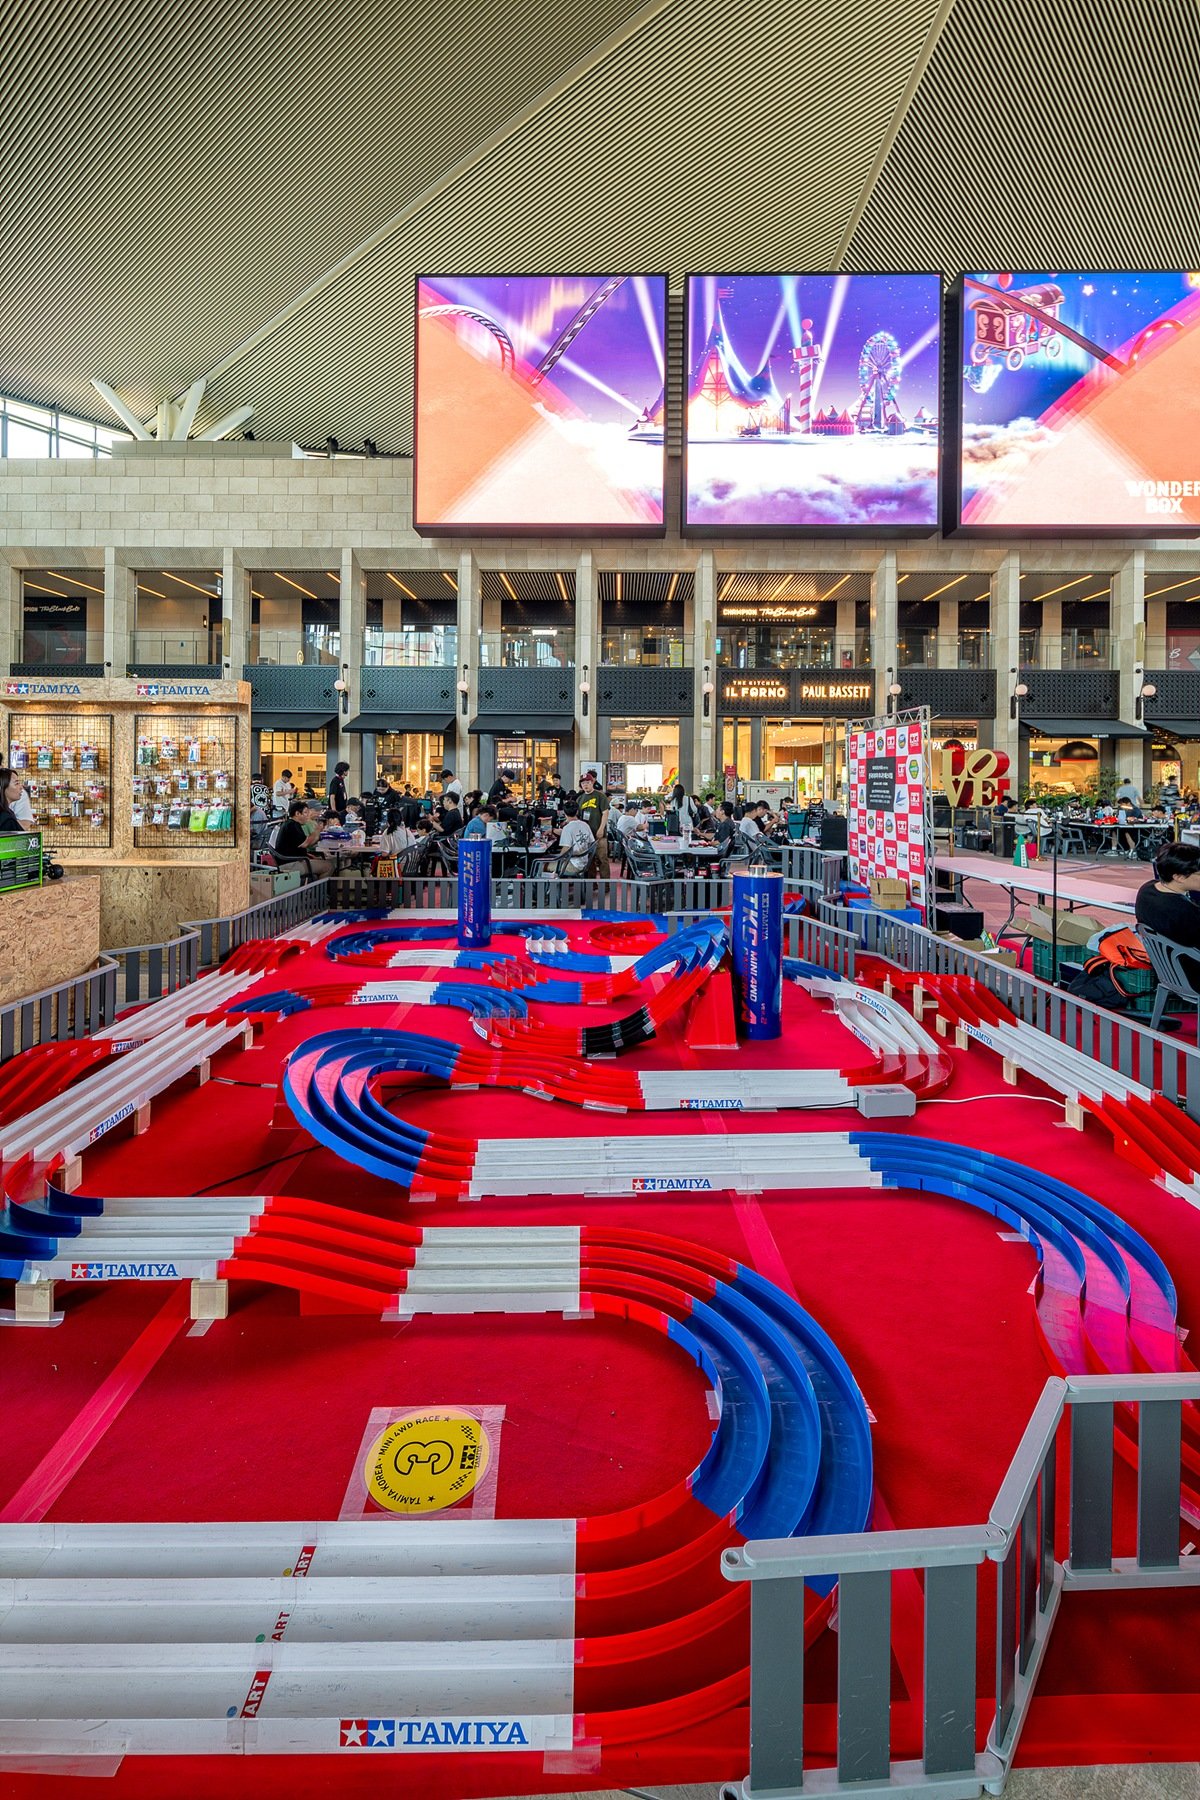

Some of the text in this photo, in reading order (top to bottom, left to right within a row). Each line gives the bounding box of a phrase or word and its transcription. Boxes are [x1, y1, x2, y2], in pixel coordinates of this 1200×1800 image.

[1145, 497, 1184, 514] BOX
[30, 685, 80, 694] TAMIYA
[160, 686, 210, 695] TAMIYA
[725, 687, 786, 698] IL FORNO
[802, 686, 871, 698] PAUL BASSETT
[742, 893, 759, 947] TKC
[750, 950, 758, 1003] MINI 4WD
[368, 994, 399, 1002] TAMIYA
[867, 995, 887, 1017] TAMIYA
[972, 1025, 993, 1047] TAMIYA
[700, 1099, 743, 1108] TAMIYA
[105, 1102, 135, 1131] TAMIYA
[657, 1179, 712, 1189] TAMIYA
[105, 1263, 179, 1277] TAMIYA
[375, 1415, 440, 1505] TAMIYA KOREA MINI 4WD RACE
[393, 1440, 454, 1475] 3
[399, 1721, 529, 1745] TAMIYA
